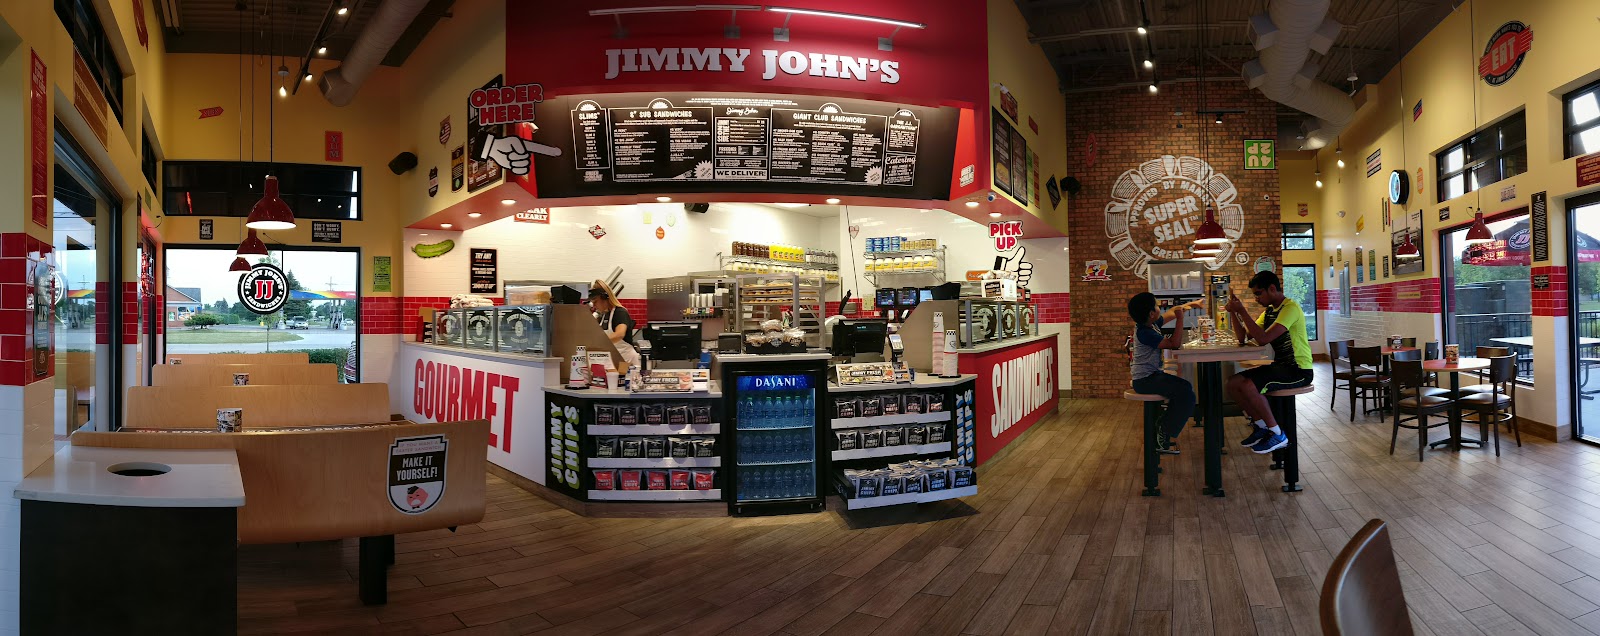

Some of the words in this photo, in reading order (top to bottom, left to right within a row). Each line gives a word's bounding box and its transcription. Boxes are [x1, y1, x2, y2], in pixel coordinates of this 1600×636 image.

[1491, 36, 1516, 71] EAT
[605, 47, 750, 80] JIMMY
[762, 49, 900, 84] JOHN'S
[470, 84, 543, 109] ORDER
[479, 103, 535, 125] HERE
[654, 110, 692, 118] SANDWICHES
[813, 114, 828, 122] CLUB
[831, 115, 866, 124] SANDWICHES
[885, 156, 916, 165] Catering
[1129, 187, 1158, 227] APPROVED
[1163, 180, 1176, 190] BY
[1144, 195, 1199, 225] SUPER
[516, 212, 548, 221] CLEARLY
[990, 222, 1022, 237] PICK
[1154, 218, 1195, 244] SEAL
[996, 236, 1016, 250] UP
[1152, 246, 1184, 259] GREAT
[245, 270, 263, 290] JIMMY
[264, 270, 284, 290] JOHN'S
[254, 279, 274, 300] JJ
[246, 295, 281, 309] SANDWICHES
[755, 375, 796, 389] DASANI
[991, 347, 1054, 439] SANDWICHES
[413, 358, 520, 454] GOURMET
[955, 393, 965, 467] JIMMY
[964, 389, 975, 463] CHIPS
[551, 402, 563, 483] JIMMY
[564, 405, 580, 489] CHIPS
[402, 456, 423, 468] MAKE
[425, 455, 433, 466] IT
[396, 466, 438, 481] YOURSELF!
